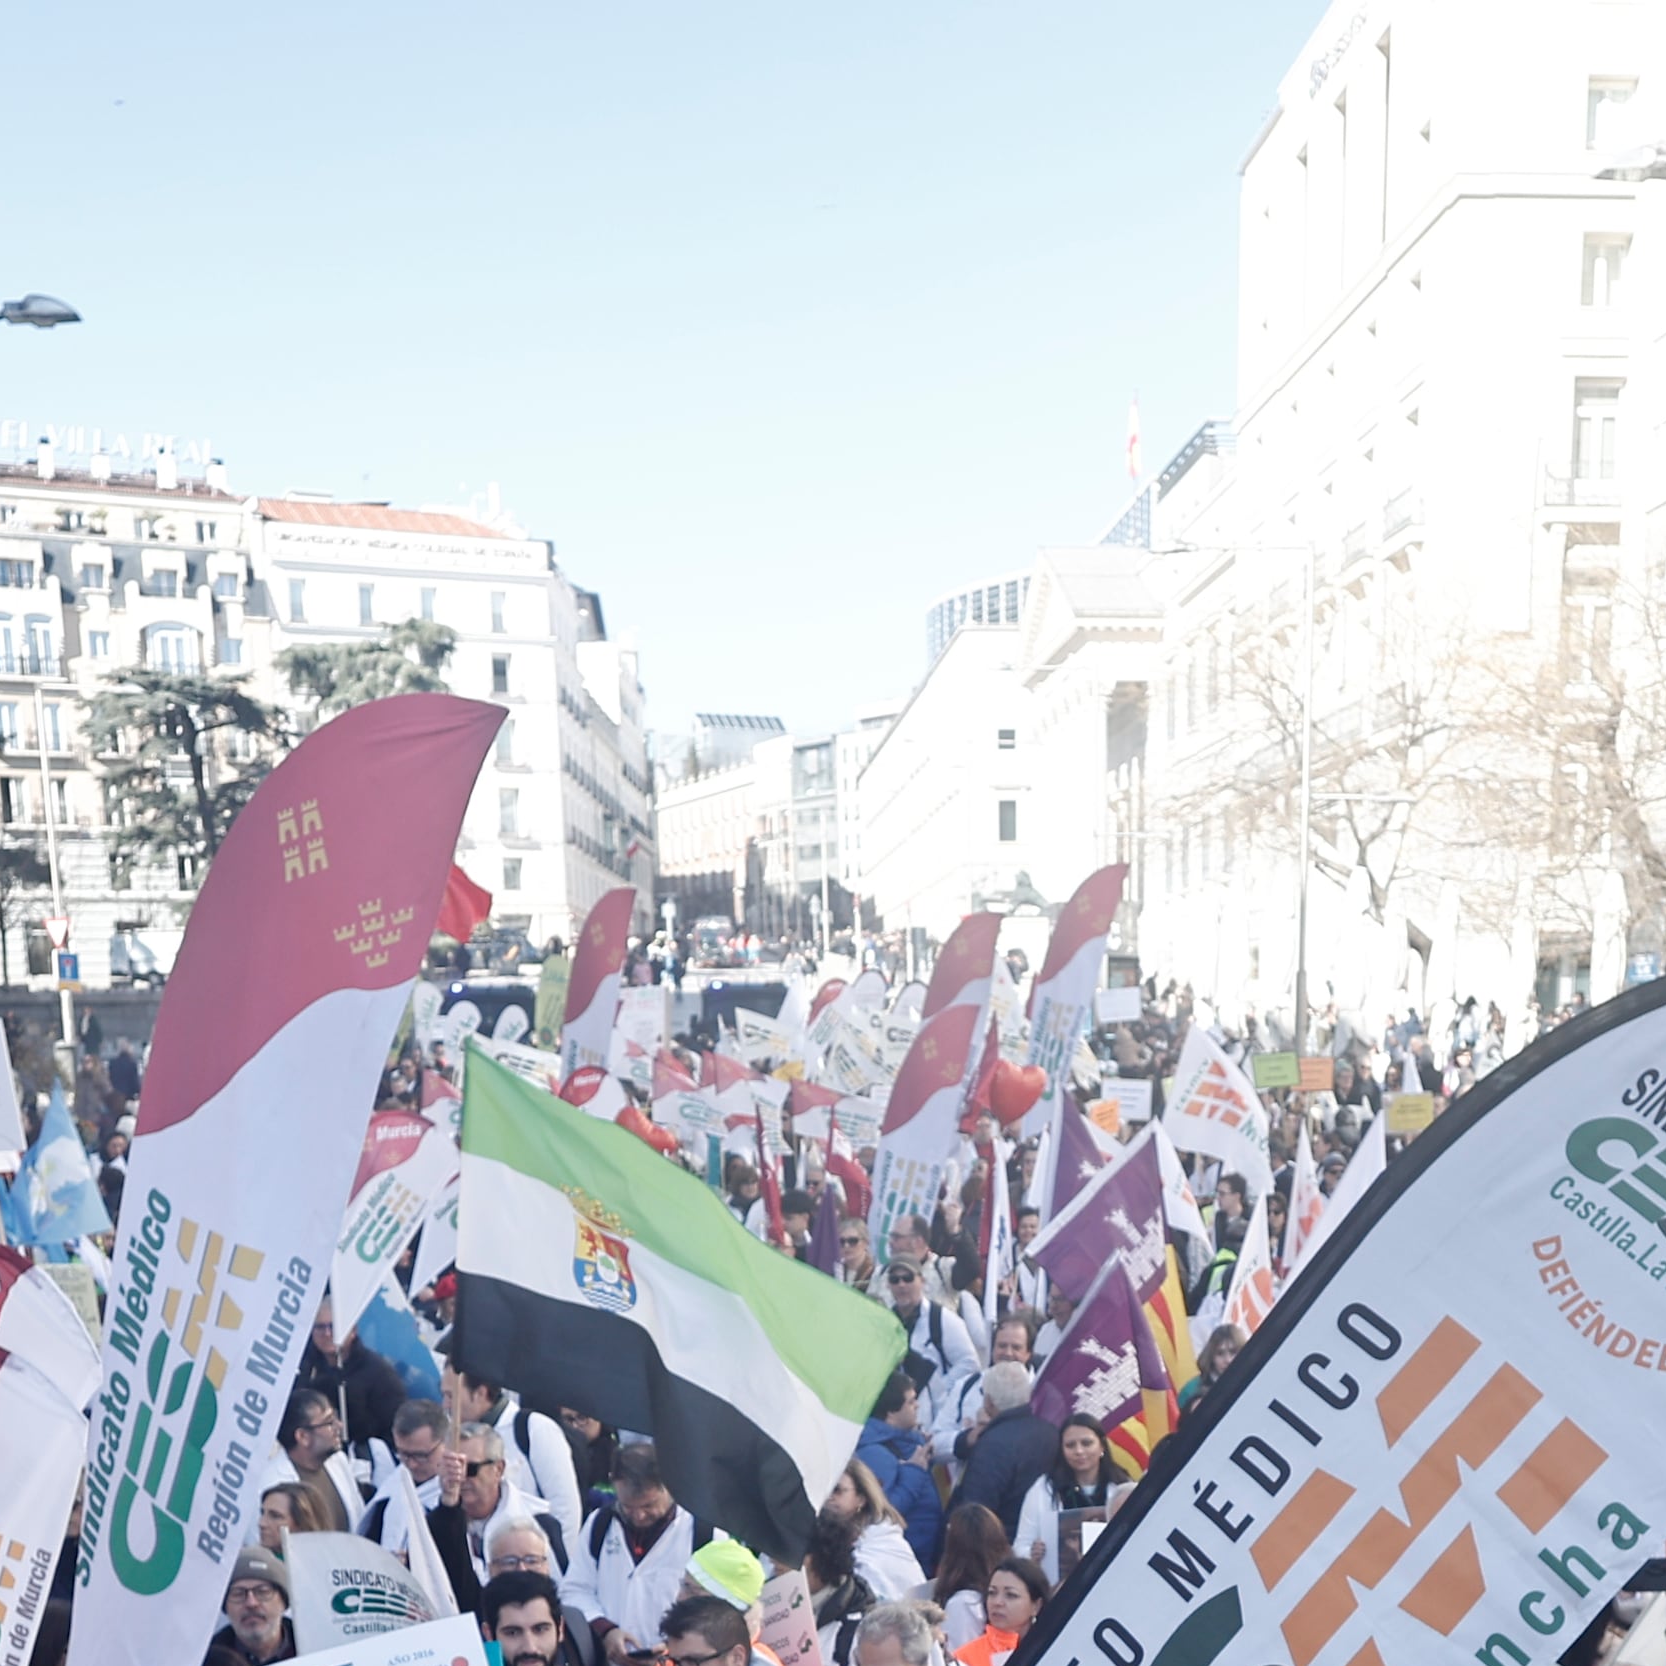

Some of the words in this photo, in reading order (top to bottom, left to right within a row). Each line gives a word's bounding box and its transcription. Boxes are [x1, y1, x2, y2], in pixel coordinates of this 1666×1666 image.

[375, 1123, 423, 1141] Murcia
[245, 1255, 313, 1387] Murcia
[75, 1373, 132, 1588] Sindicato
[109, 1188, 171, 1367] Médico
[109, 1217, 265, 1596] CESM
[232, 1387, 269, 1438] de
[1147, 1302, 1404, 1603] MÉDICO
[197, 1440, 253, 1565] Región
[18, 1546, 53, 1622] Murcia
[331, 1569, 396, 1591] SINDICATO
[11, 1616, 32, 1656] de
[412, 1648, 435, 1662] 2016
